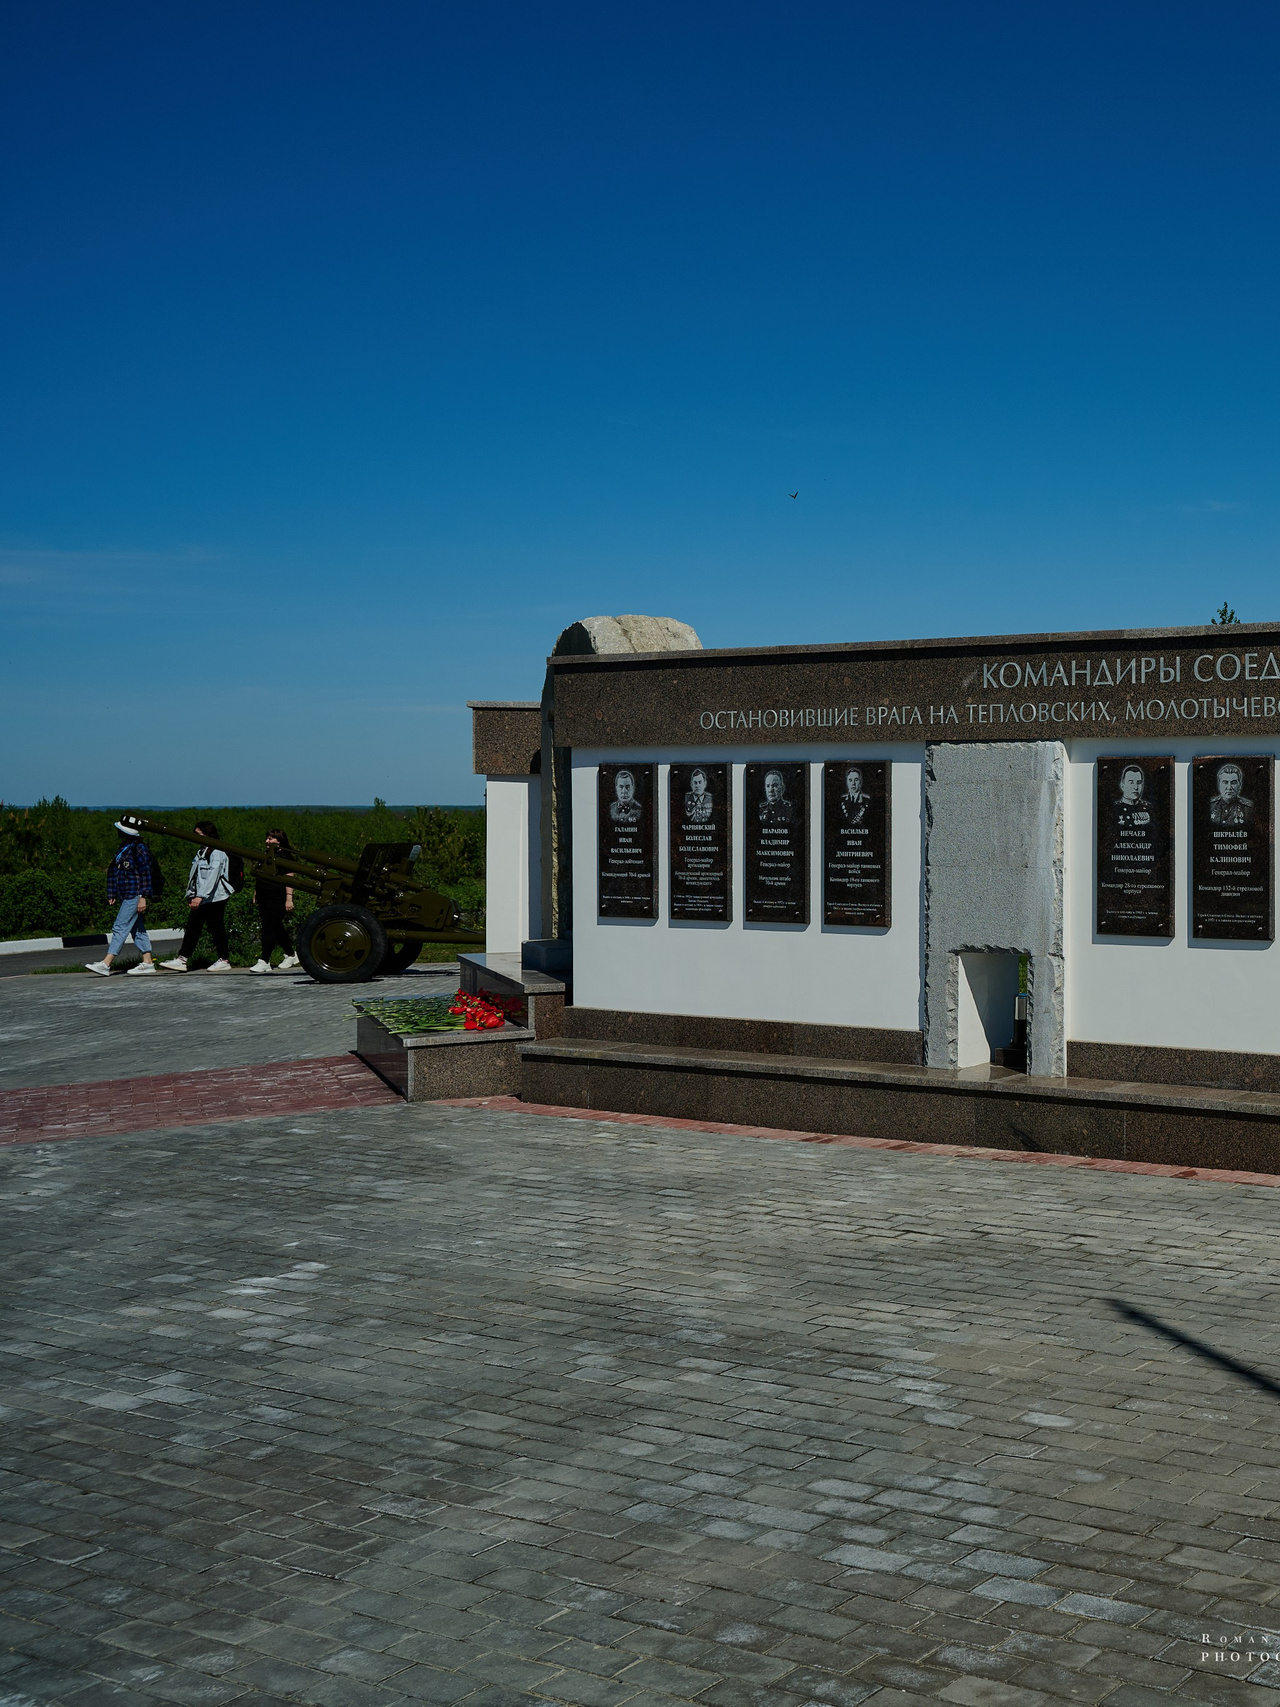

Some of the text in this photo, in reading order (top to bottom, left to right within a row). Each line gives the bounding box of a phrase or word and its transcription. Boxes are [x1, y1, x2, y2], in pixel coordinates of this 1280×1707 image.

[983, 656, 1181, 689] КОМАНДИРЫ
[699, 707, 859, 729] ОСТАНОВИВШИЕ
[866, 705, 923, 727] ВРАГА
[930, 704, 959, 725] НА
[965, 701, 1117, 725] ТЕПЛОВСКИХ,
[1213, 843, 1248, 851] ТИМОФЕЙ
[1111, 854, 1156, 862] НИКОЛАЕВИЧ
[1114, 867, 1153, 875] Генерал-майор
[1211, 869, 1252, 877] Генерал-майор
